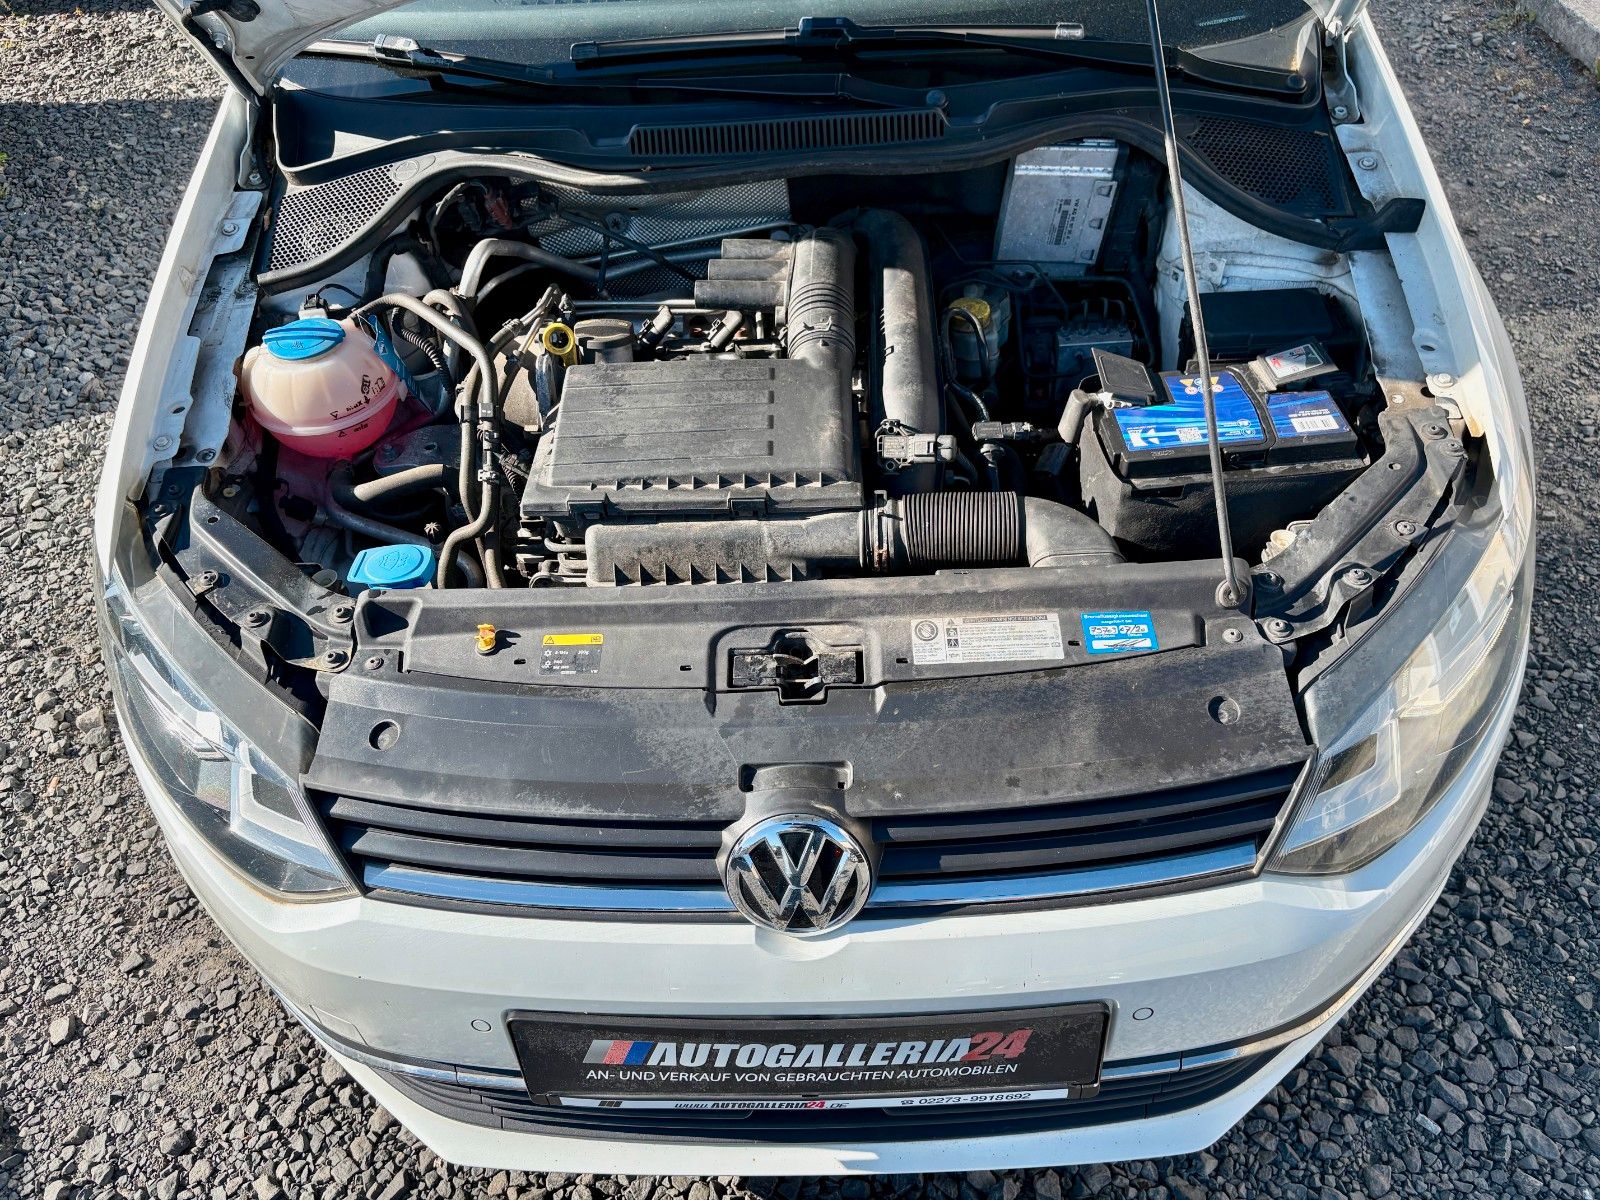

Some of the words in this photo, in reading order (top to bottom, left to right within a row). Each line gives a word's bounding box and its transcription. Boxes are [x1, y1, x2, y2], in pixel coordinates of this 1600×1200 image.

[728, 816, 868, 935] VW
[646, 1026, 1034, 1068] AUTOGALLERIA24
[586, 1070, 616, 1080] AN-
[619, 1070, 656, 1081] UND
[659, 1071, 731, 1082] VERKAUF
[735, 1072, 771, 1082] VON
[774, 1070, 895, 1082] GEBRAUCHTEN
[897, 1063, 1018, 1079] AUTOMOBILEN
